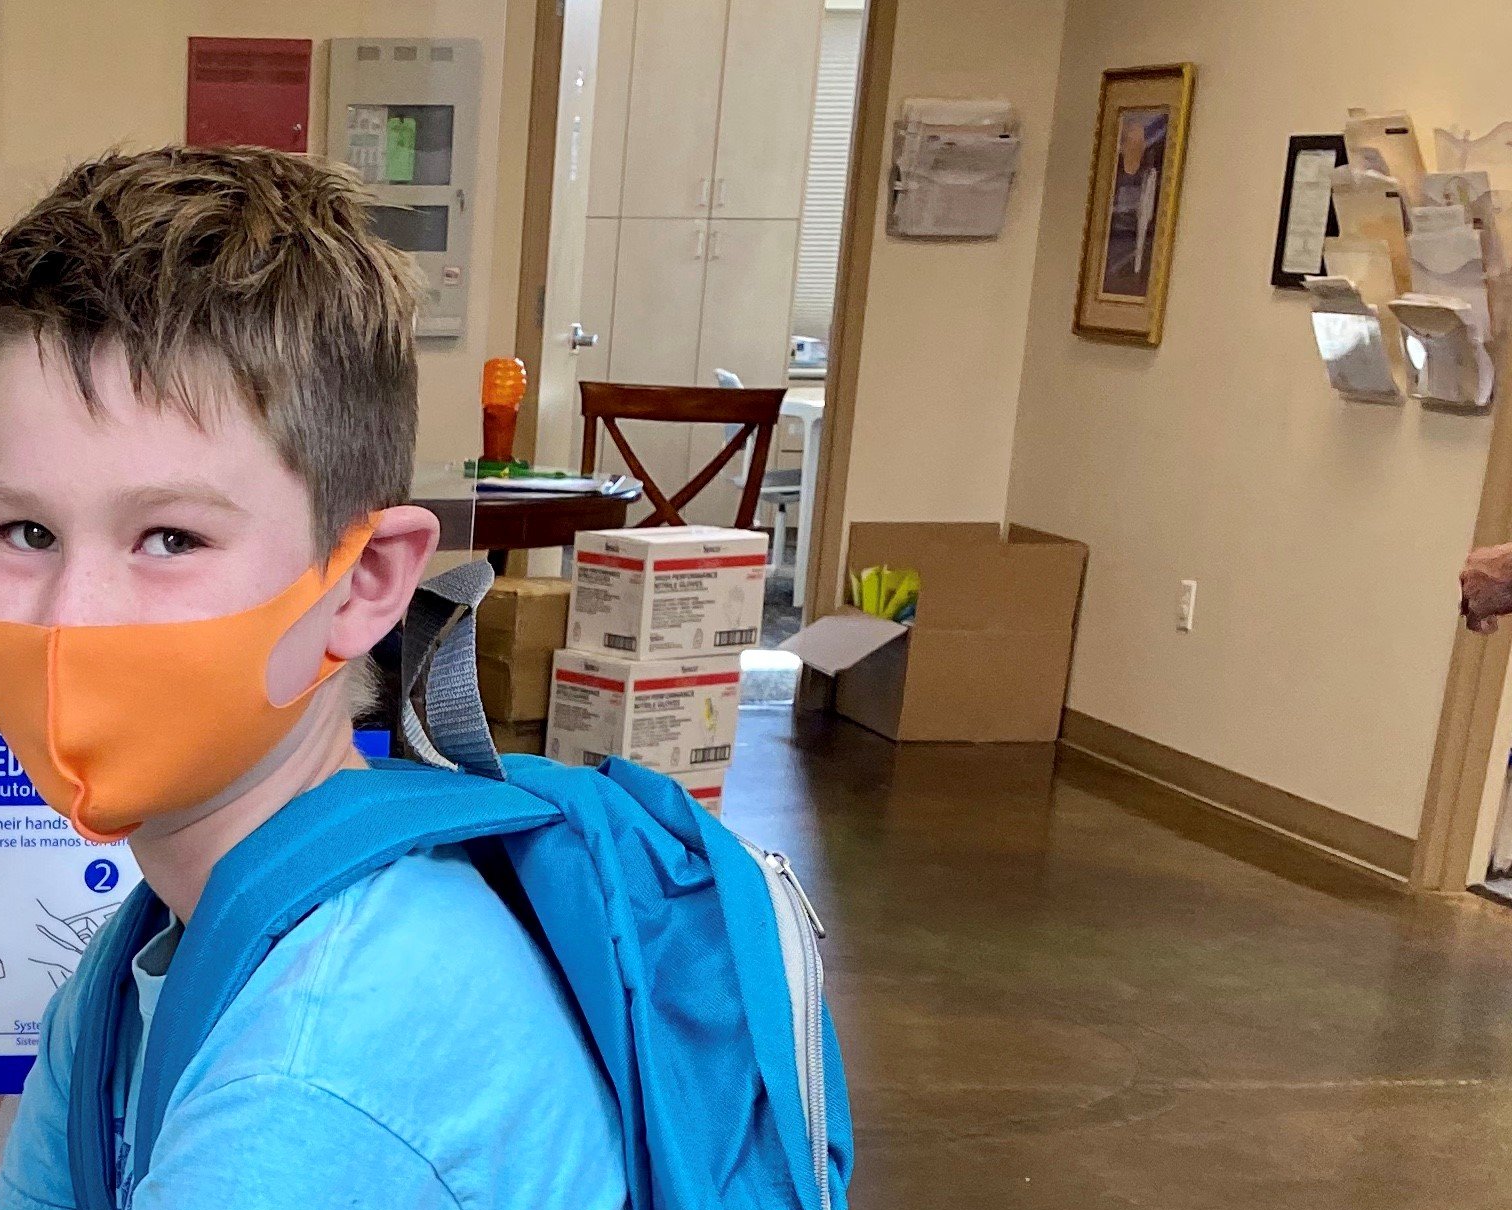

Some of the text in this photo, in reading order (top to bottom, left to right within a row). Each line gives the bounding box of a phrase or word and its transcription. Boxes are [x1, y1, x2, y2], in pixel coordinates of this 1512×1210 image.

[25, 816, 69, 830] hands
[20, 835, 37, 847] las
[40, 838, 81, 847] manos
[93, 862, 112, 891] 2
